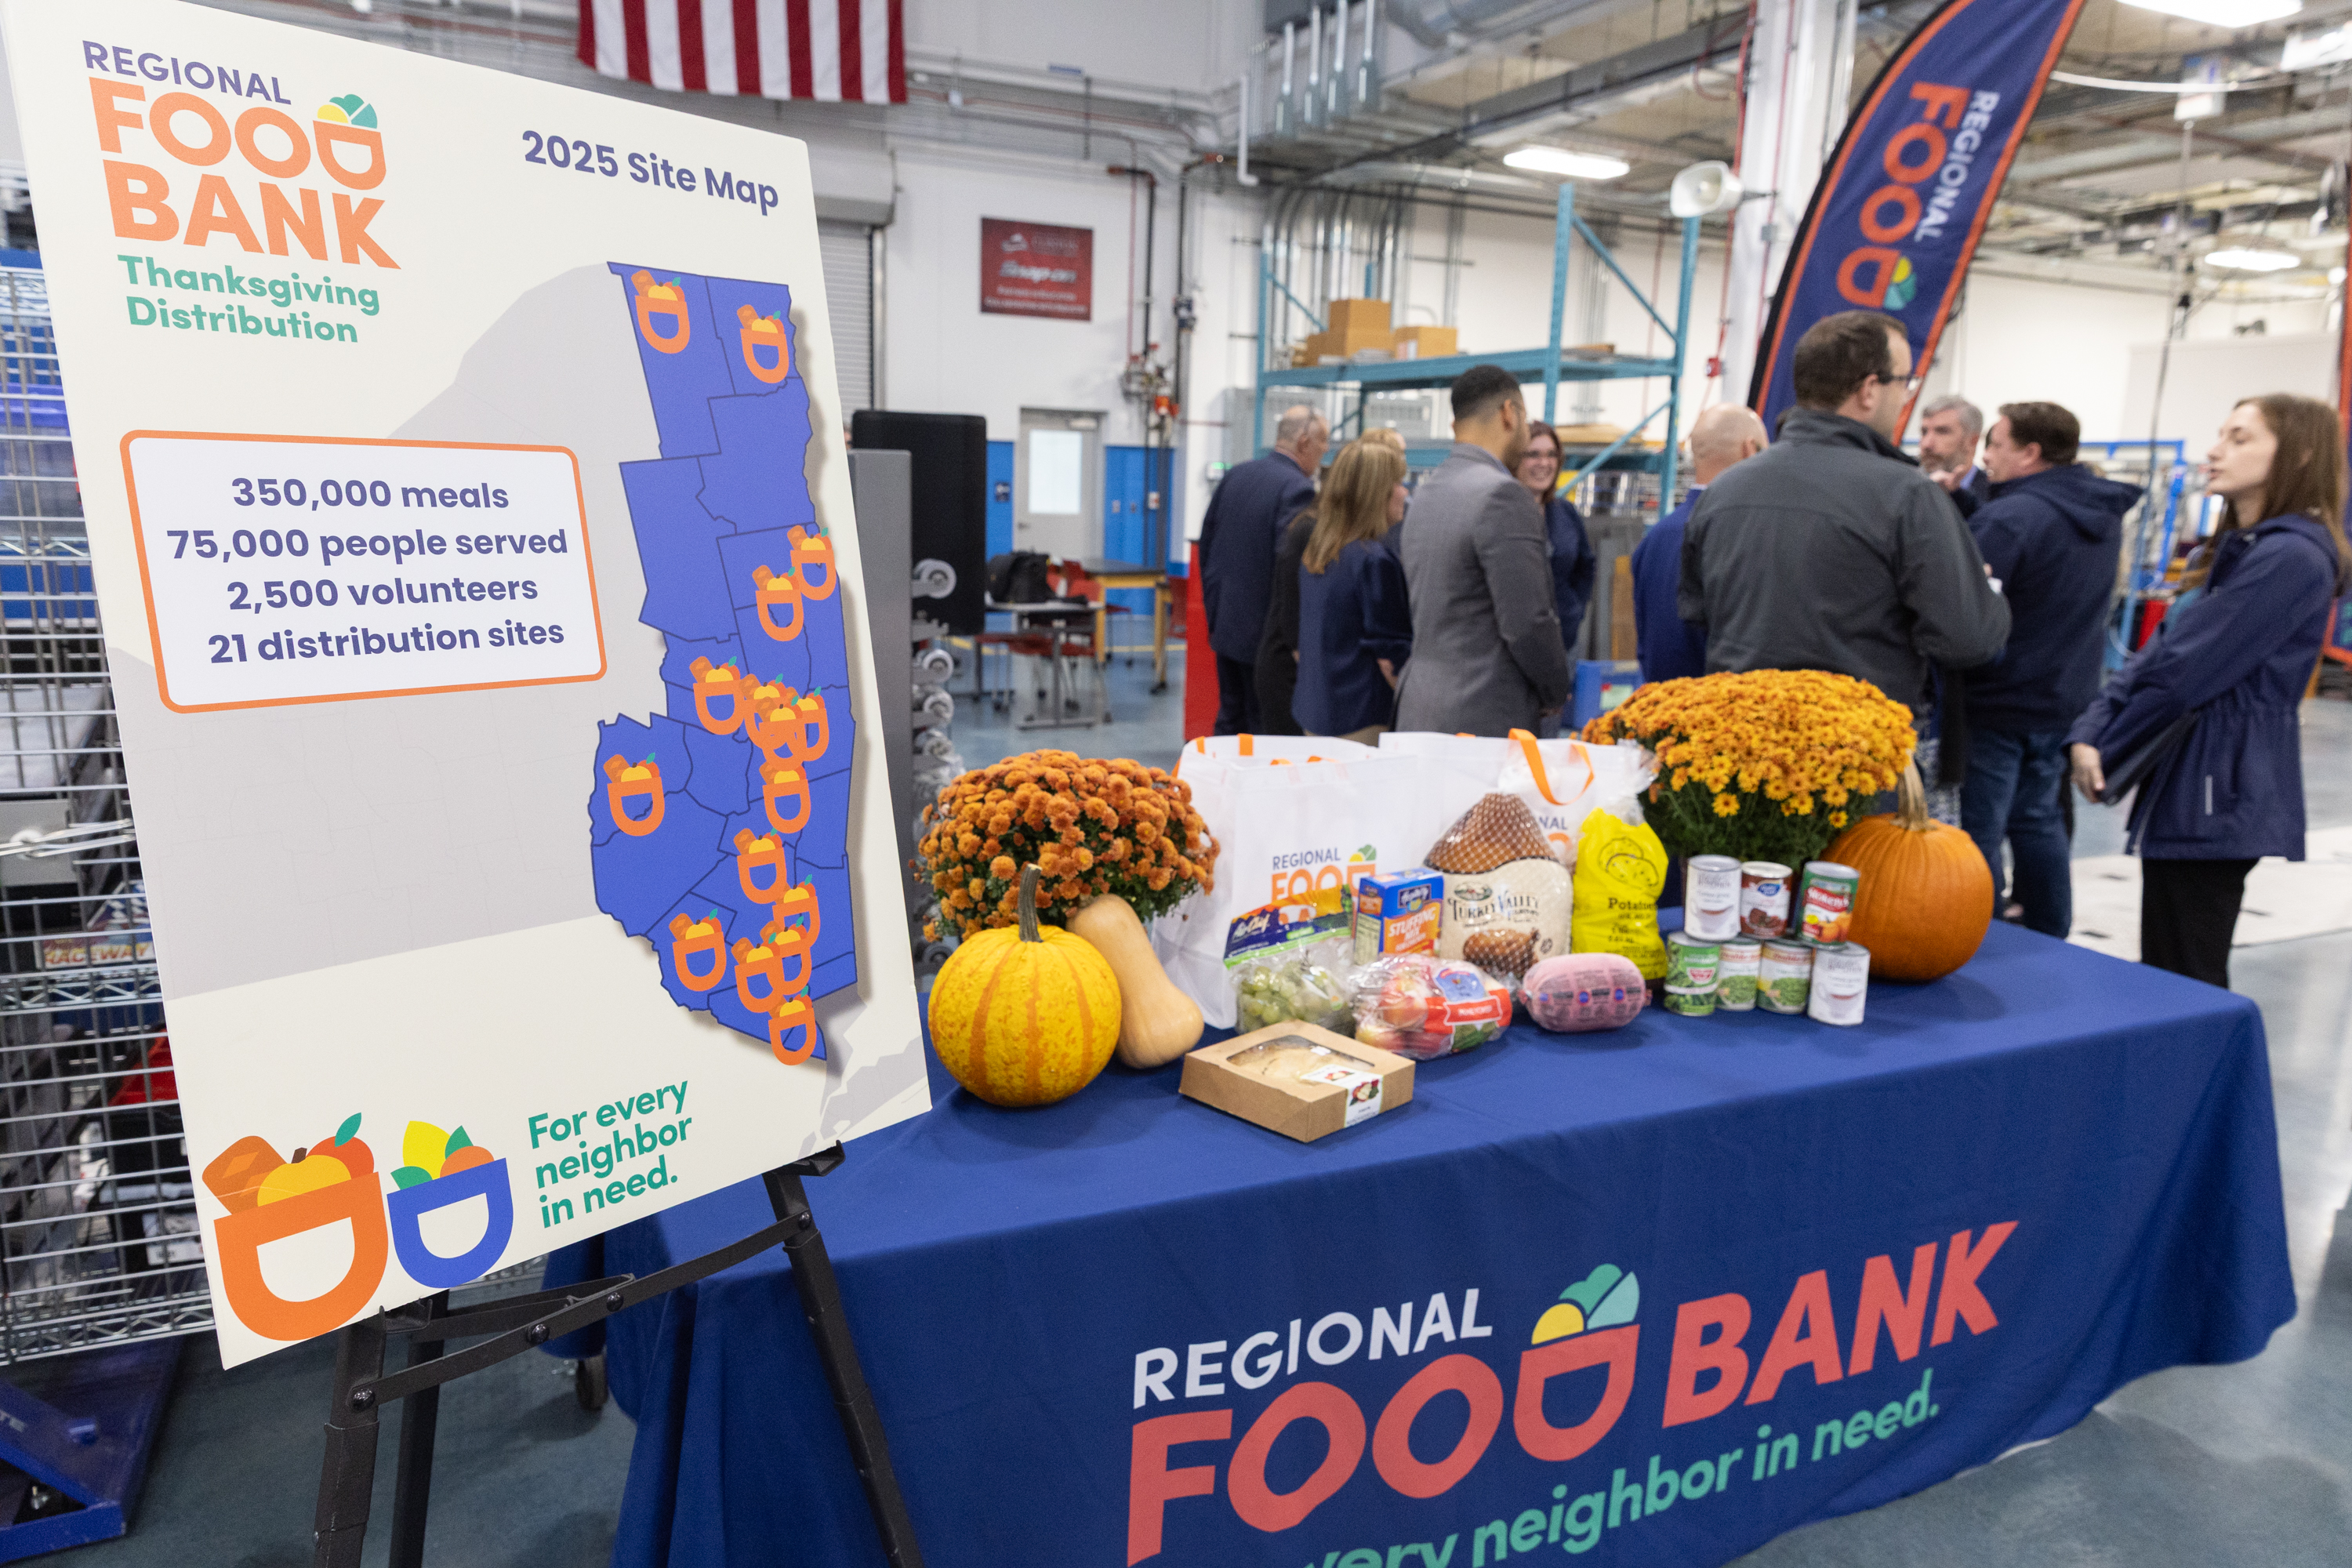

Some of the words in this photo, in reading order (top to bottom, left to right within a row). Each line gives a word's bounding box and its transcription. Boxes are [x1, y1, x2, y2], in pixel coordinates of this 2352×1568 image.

[82, 40, 292, 105] REGIONAL
[89, 76, 387, 190] FOOD
[1915, 90, 2000, 243] REGIONAL
[522, 130, 619, 177] 2025
[627, 152, 697, 192] Site
[704, 167, 779, 216] Map
[1836, 81, 1971, 308] FOOD
[103, 159, 401, 270] BANK
[118, 254, 379, 316] Thanksgiving
[126, 296, 358, 343] Distribution
[231, 477, 391, 511] 350,000
[401, 482, 509, 509] meals
[166, 528, 309, 563] 75,000
[319, 528, 447, 566] people
[456, 528, 568, 555] served
[227, 579, 339, 615] 2,500
[347, 577, 539, 606] volunteers
[208, 633, 248, 664] 21
[257, 622, 481, 661] distribution
[488, 619, 564, 648] sites
[1272, 848, 1341, 870] REGIONAL
[528, 1110, 587, 1149] For
[596, 1080, 688, 1127] every
[535, 1116, 692, 1189] neighbor
[539, 1194, 574, 1229] in
[583, 1154, 678, 1214] need.
[1134, 1288, 1493, 1409] REGIONAL
[1127, 1323, 1640, 1567] FOOD
[1663, 1221, 2019, 1428] BANK
[1472, 1448, 1743, 1567] neighbor
[1752, 1424, 1799, 1481] in
[1811, 1368, 1939, 1461] need.
